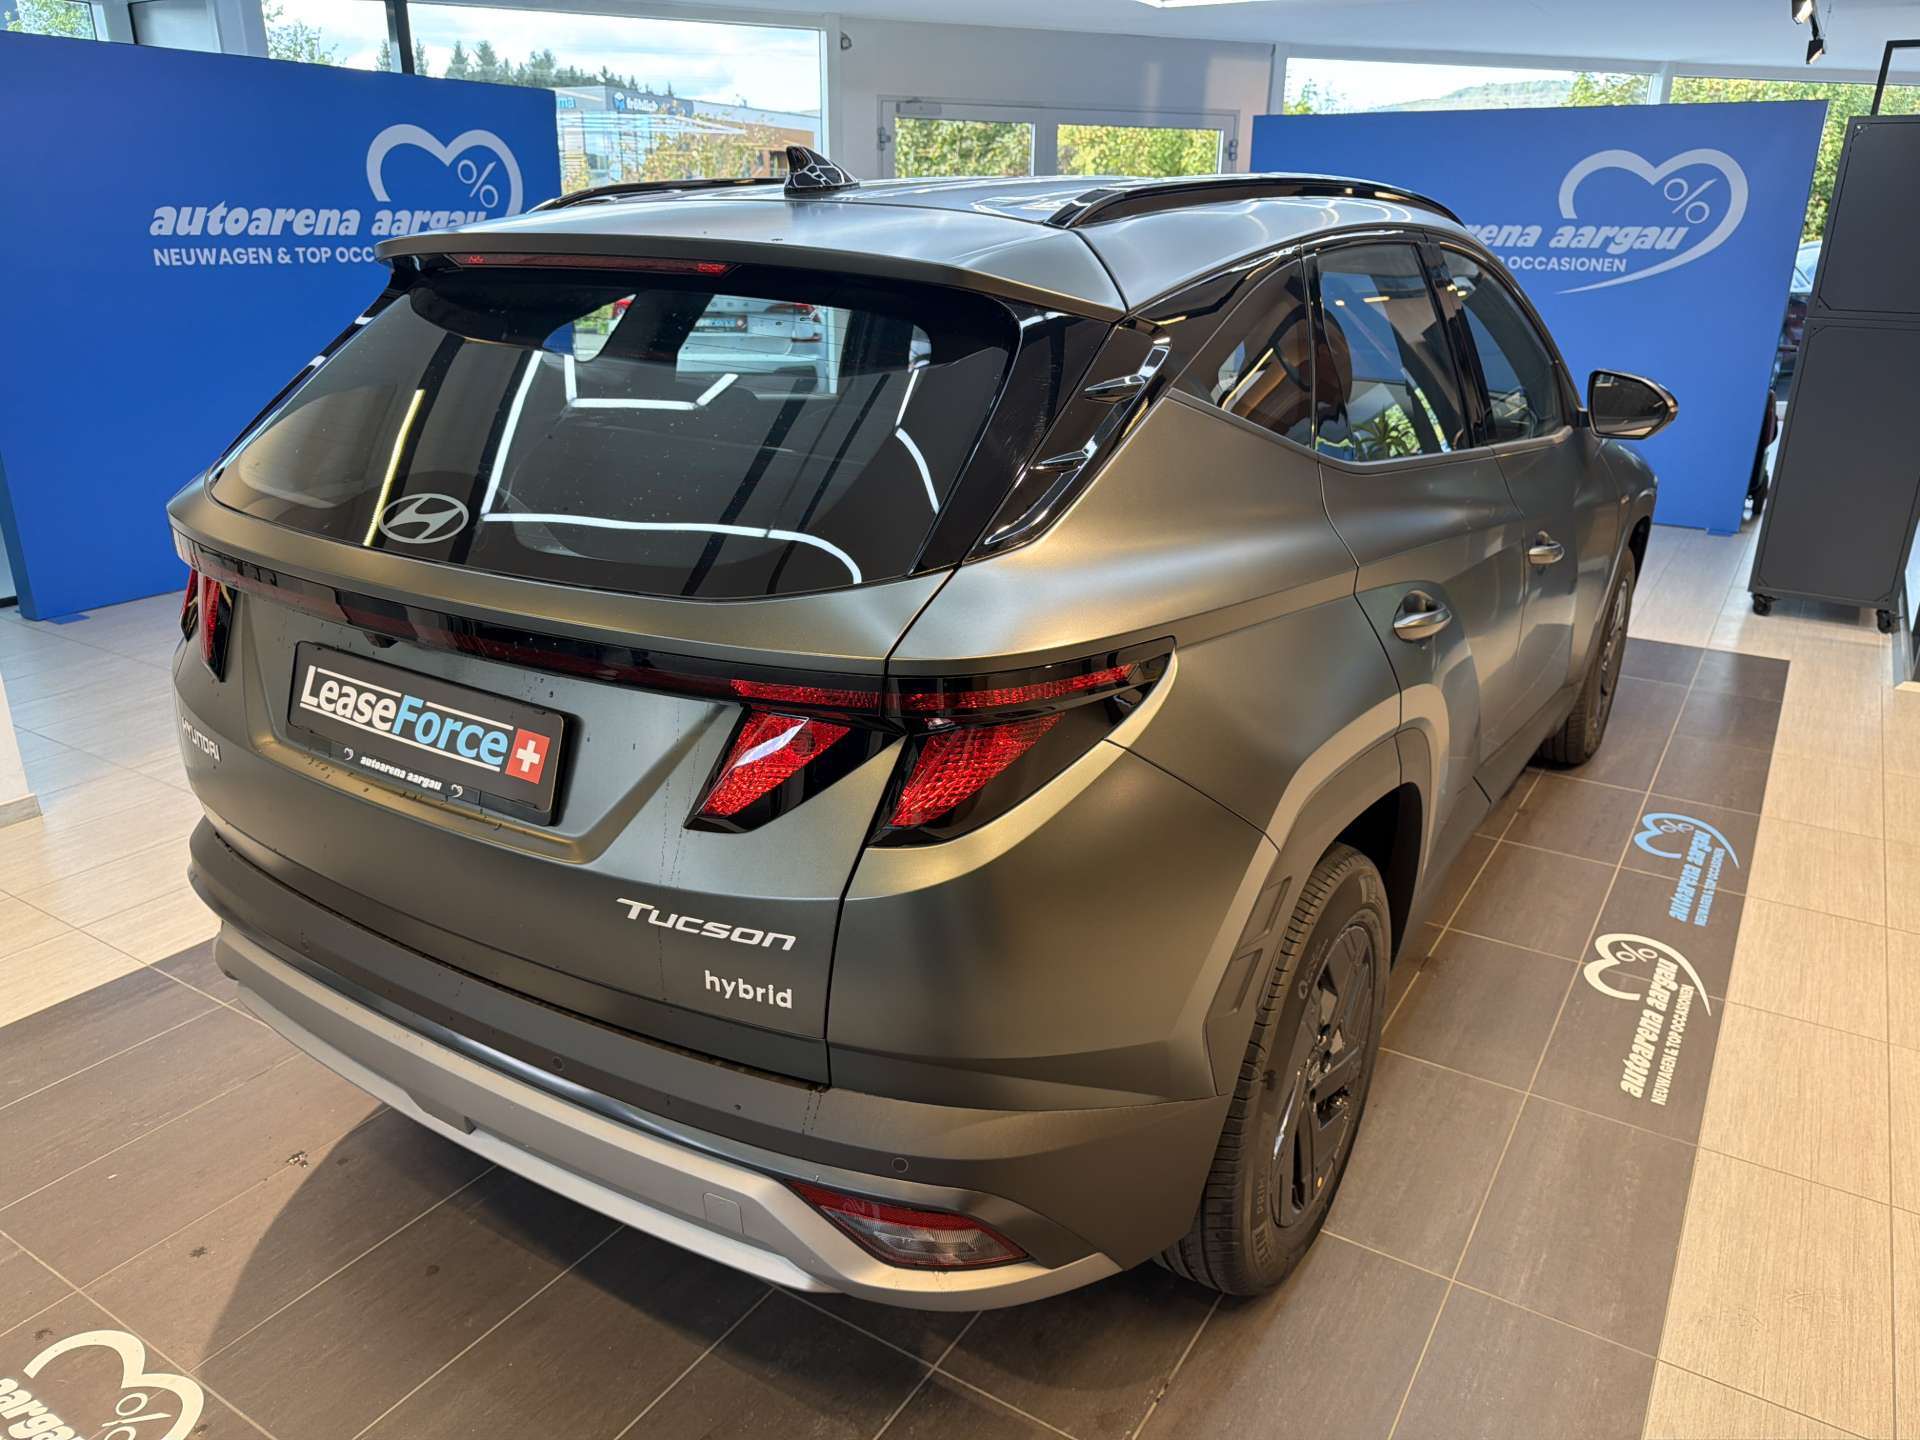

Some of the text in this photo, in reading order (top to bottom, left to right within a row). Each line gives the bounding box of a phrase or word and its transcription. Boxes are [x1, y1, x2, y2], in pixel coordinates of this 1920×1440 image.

[150, 200, 361, 237] autoarena
[153, 248, 273, 267] NEUWAGEN
[277, 248, 293, 263] &
[295, 247, 331, 264] TOP
[1549, 225, 1689, 255] aargau
[1507, 255, 1628, 273] OCCASIONEN
[301, 664, 509, 766] LeaseForce
[360, 756, 443, 792] autoarena aargau
[704, 969, 792, 1009] hybrid
[1670, 983, 1695, 1034] OCCASIONEN
[1620, 957, 1679, 1098] autoarena aargau
[1666, 1030, 1683, 1049] TOP
[1650, 1054, 1679, 1106] NEUWAGEN
